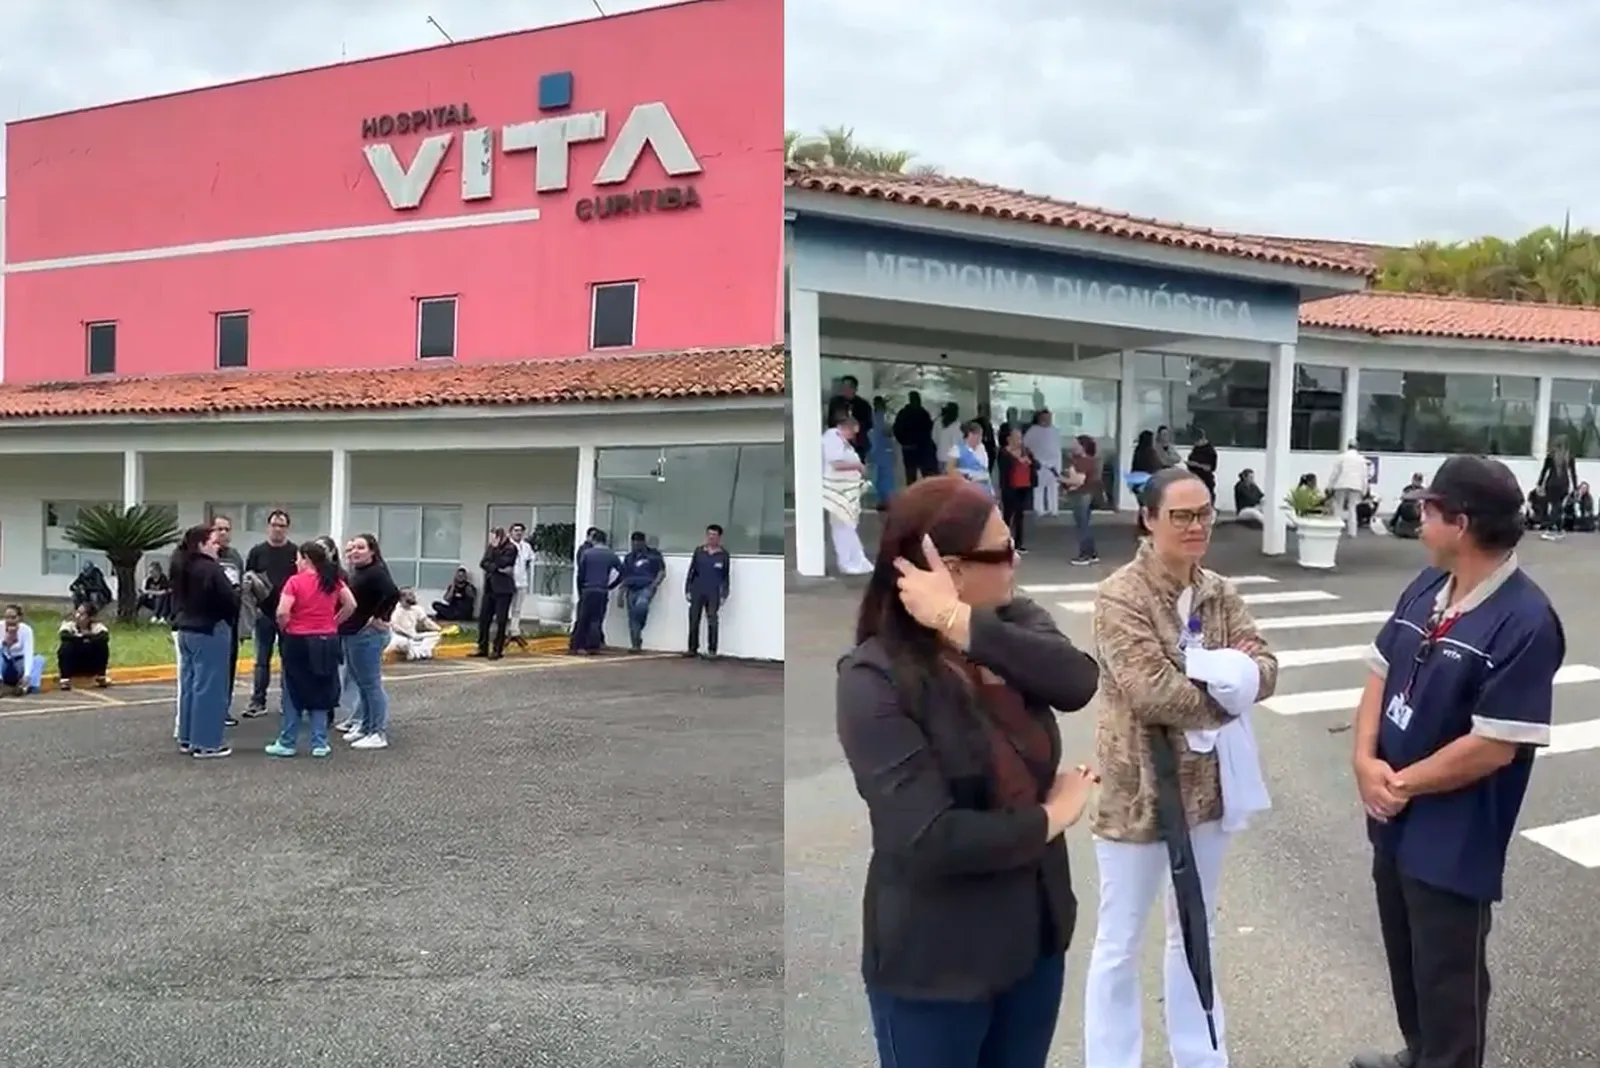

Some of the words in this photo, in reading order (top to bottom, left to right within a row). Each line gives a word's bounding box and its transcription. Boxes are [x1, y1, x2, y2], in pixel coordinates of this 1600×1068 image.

[362, 103, 477, 139] HOSPITAL
[363, 101, 703, 210] VITA
[575, 186, 702, 221] CURITIBA
[865, 251, 1040, 296] MEDICINA
[1053, 276, 1253, 325] DIAGNÓSTICA
